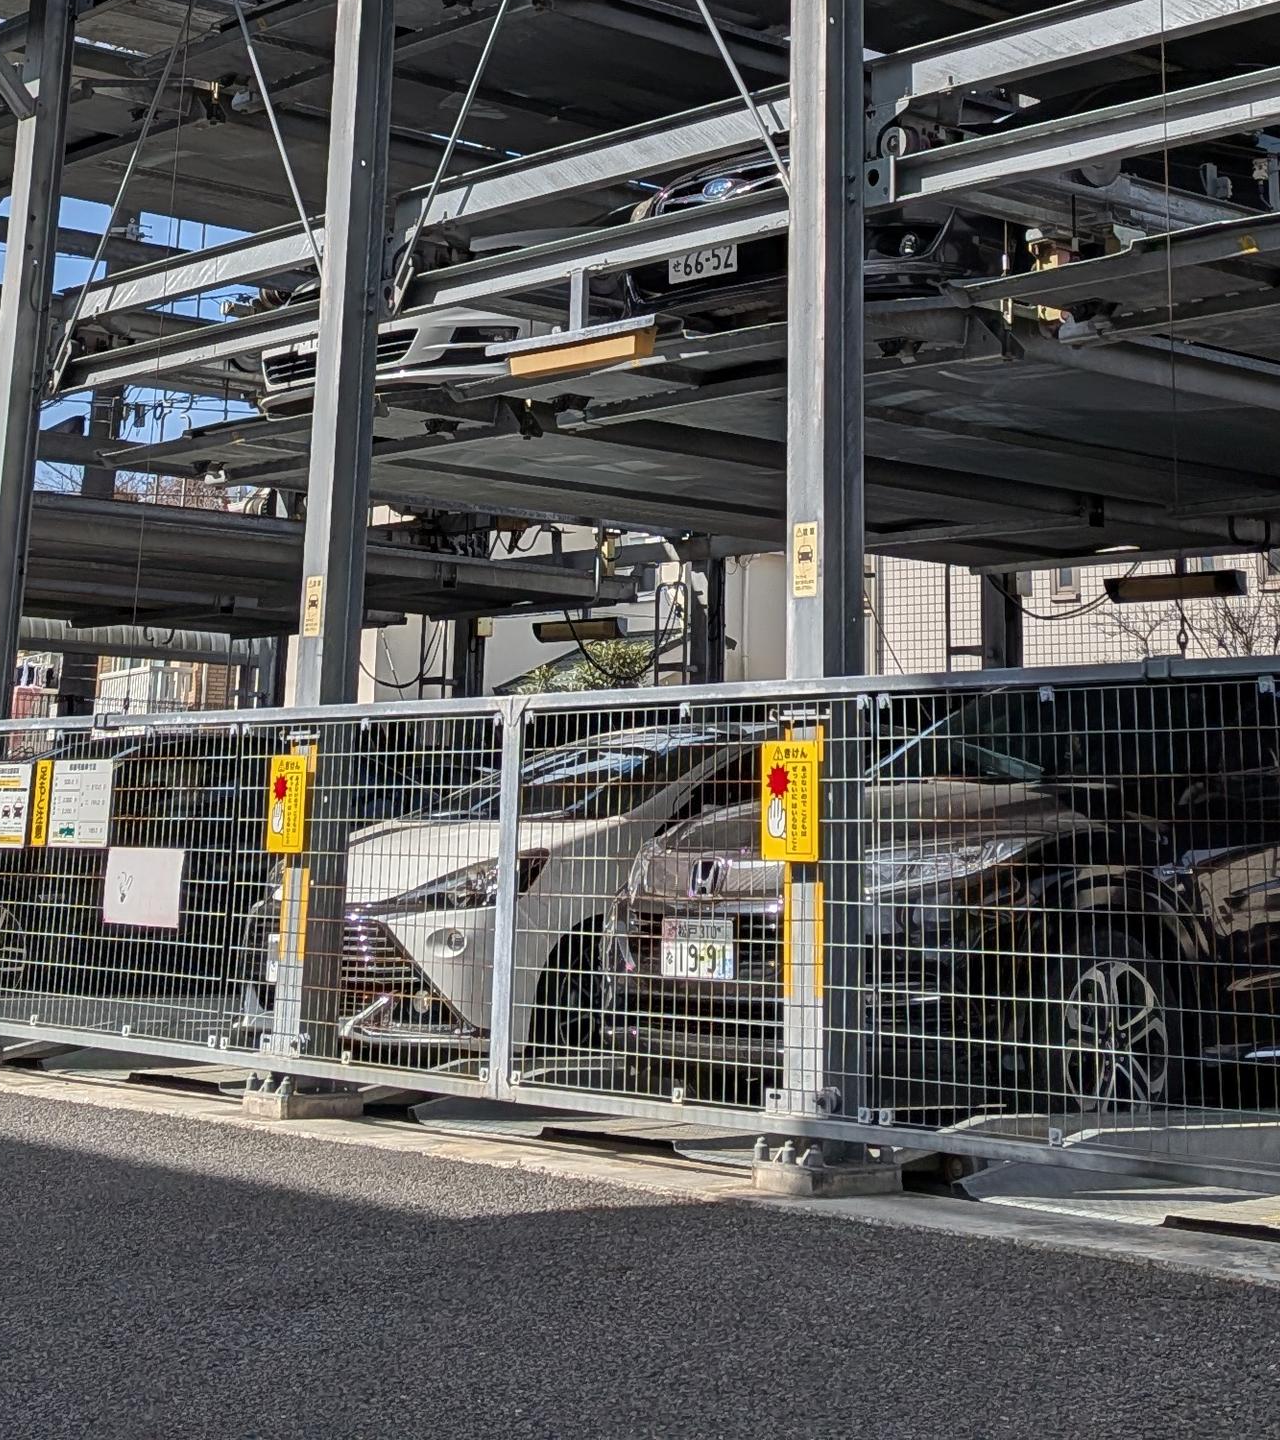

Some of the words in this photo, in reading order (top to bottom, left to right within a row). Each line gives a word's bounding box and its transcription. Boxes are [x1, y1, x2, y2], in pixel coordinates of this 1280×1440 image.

[673, 260, 681, 272] せ
[684, 246, 733, 276] 66-52
[784, 747, 808, 759] きけん
[679, 943, 726, 974] 19-91
